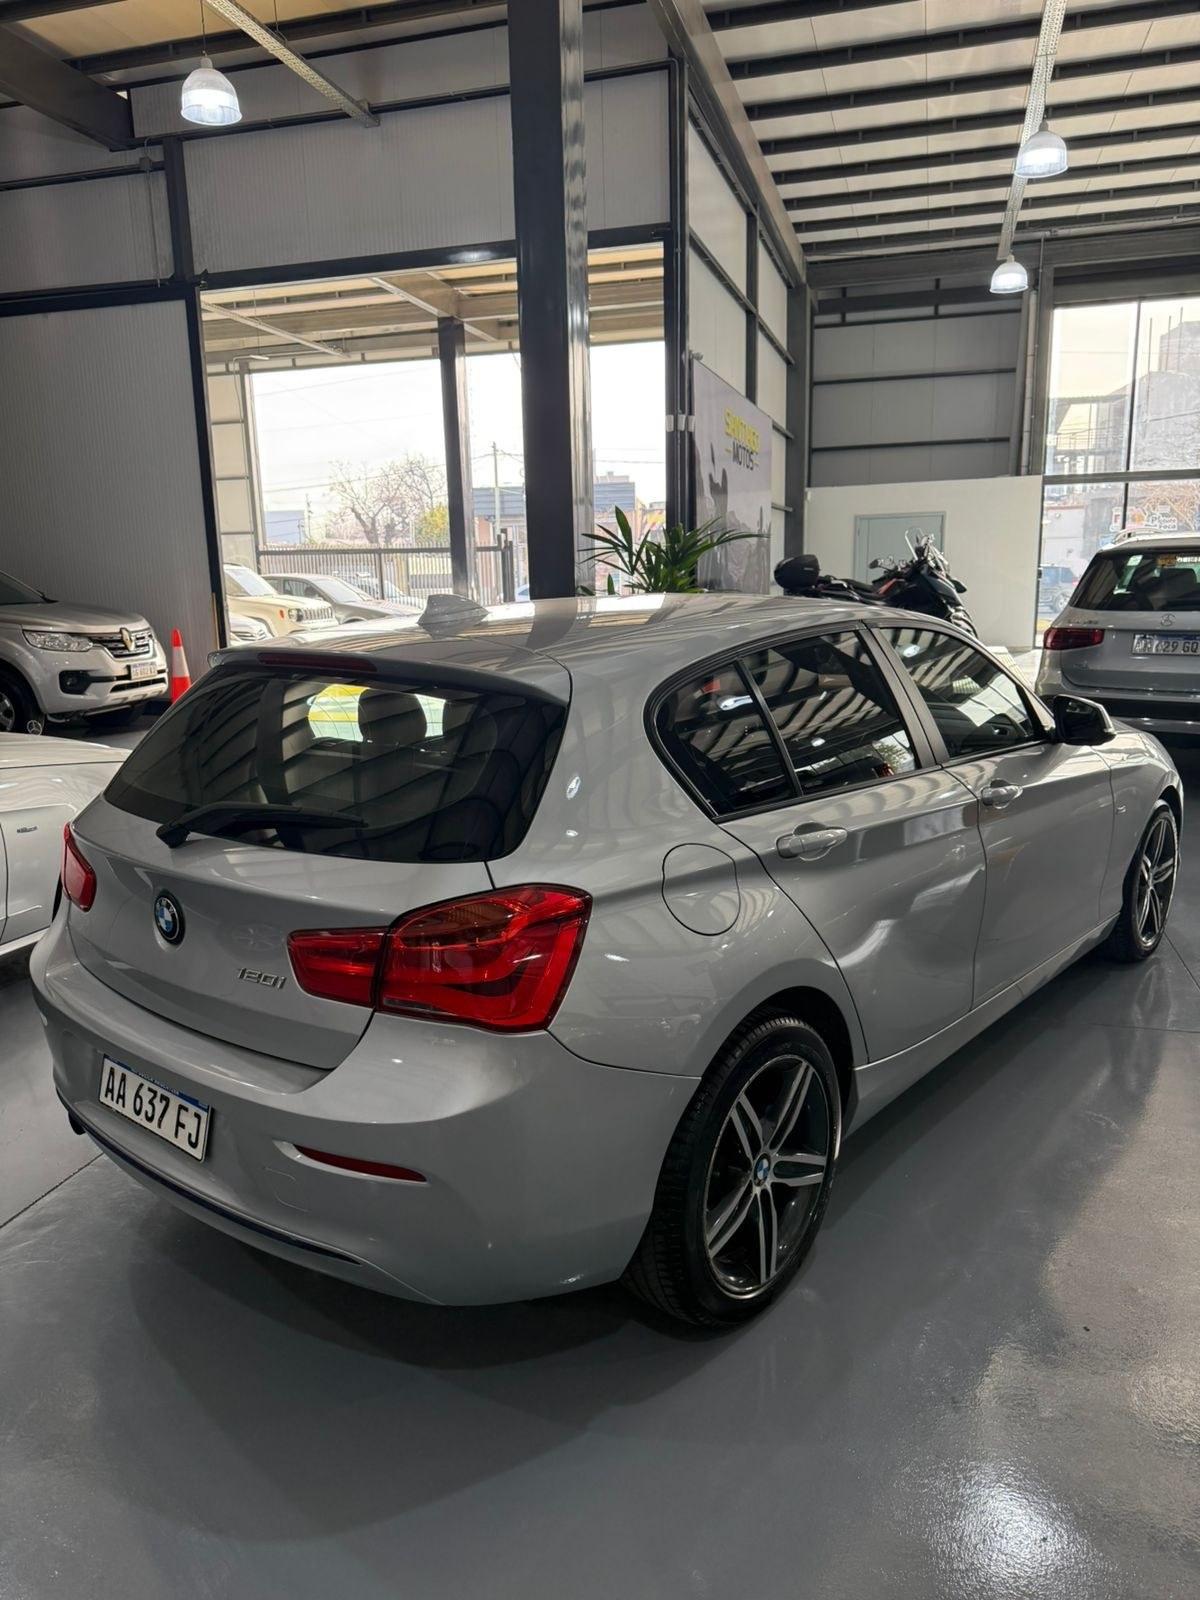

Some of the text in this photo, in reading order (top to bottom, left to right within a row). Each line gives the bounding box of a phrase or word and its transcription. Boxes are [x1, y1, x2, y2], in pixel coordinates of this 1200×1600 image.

[732, 440, 753, 471] MOTOS
[1183, 641, 1199, 653] GQ
[237, 967, 287, 990] 120i
[104, 1066, 127, 1108] AA
[133, 1082, 171, 1129] 637
[174, 1103, 202, 1149] FJ
